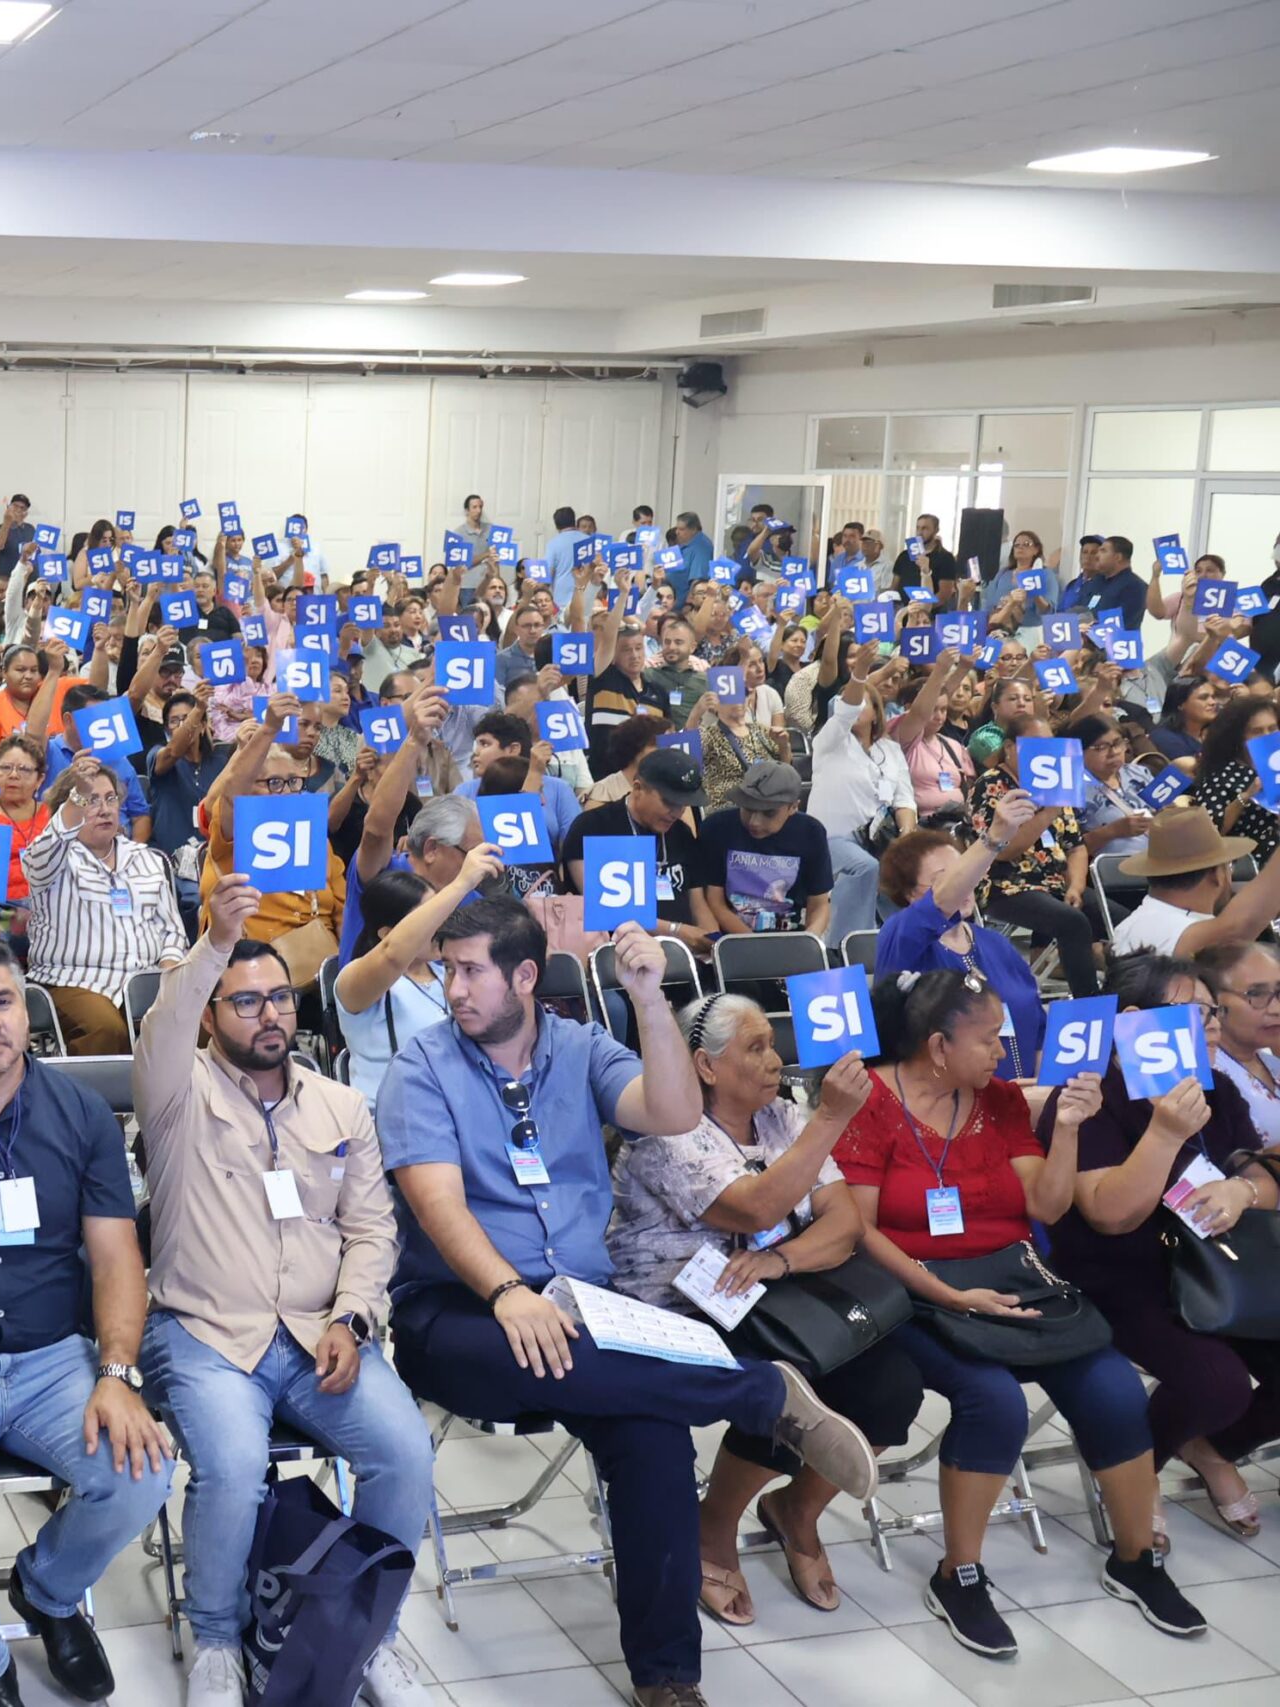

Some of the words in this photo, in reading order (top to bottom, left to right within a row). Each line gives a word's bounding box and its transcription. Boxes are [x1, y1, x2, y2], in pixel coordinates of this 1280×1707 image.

[183, 503, 198, 517] SI
[221, 506, 235, 517] SI
[223, 520, 238, 532] SI
[37, 529, 56, 544] SI
[175, 534, 191, 547] SI
[492, 531, 509, 543] SI
[638, 530, 656, 543] SI
[256, 539, 274, 555] SI
[450, 548, 468, 562] SI
[498, 547, 515, 561] SI
[577, 543, 593, 560] SI
[909, 541, 924, 556] SI
[91, 553, 110, 569] SI
[377, 550, 396, 565] SI
[614, 551, 637, 568] SI
[1164, 553, 1186, 568] SI
[43, 560, 63, 576] SI
[135, 558, 158, 577] SI
[161, 561, 179, 577] SI
[529, 564, 547, 578] SI
[713, 565, 732, 580] SI
[228, 581, 245, 599] SI
[845, 577, 868, 594] SI
[1021, 575, 1043, 592] SI
[86, 597, 107, 617] SI
[727, 594, 744, 611] SI
[1203, 587, 1227, 609] SI
[1237, 593, 1262, 611] SI
[167, 599, 192, 621] SI
[305, 604, 326, 625] SI
[354, 604, 377, 621] SI
[52, 616, 82, 641] SI
[244, 622, 265, 640] SI
[739, 614, 764, 634] SI
[861, 612, 888, 634] SI
[449, 625, 470, 642] SI
[942, 624, 969, 645] SI
[1051, 622, 1071, 643] SI
[1094, 627, 1114, 642] S
[560, 643, 587, 665] SI
[909, 635, 930, 656] SI
[1112, 640, 1137, 660] SI
[1217, 650, 1249, 677] SI
[286, 661, 321, 689] SI
[446, 657, 484, 690] SI
[1043, 667, 1071, 688] SI
[717, 674, 736, 696] SI
[88, 713, 129, 750] SI
[370, 717, 401, 743] SI
[546, 712, 579, 740] SI
[1030, 750, 1074, 790] SI
[1151, 775, 1181, 803] SI
[493, 811, 539, 848] SI
[252, 821, 310, 869] SI
[600, 862, 645, 907] SI
[808, 992, 862, 1041] SI
[1056, 1020, 1102, 1064] SI
[1134, 1025, 1196, 1074] SI
